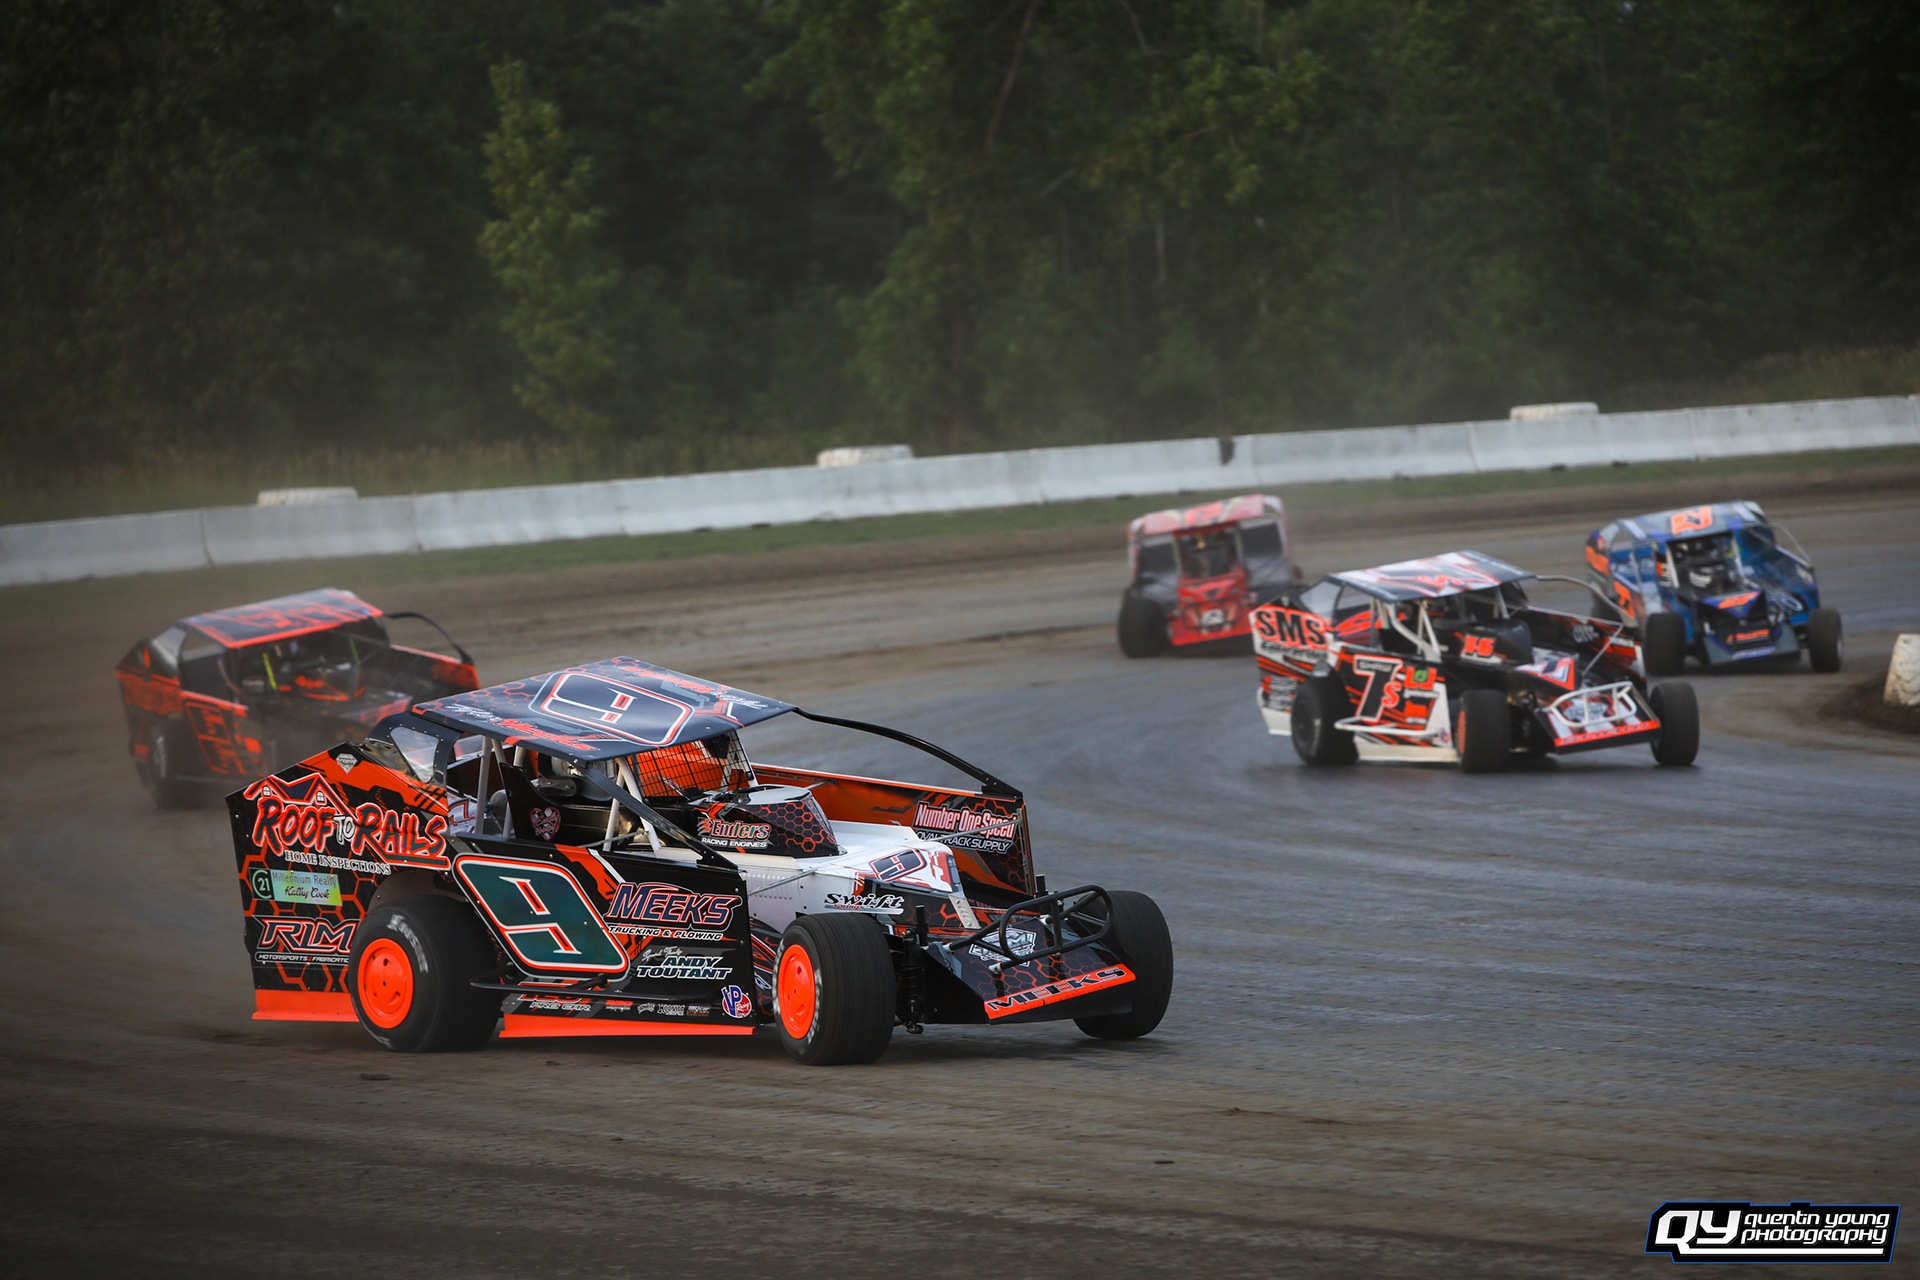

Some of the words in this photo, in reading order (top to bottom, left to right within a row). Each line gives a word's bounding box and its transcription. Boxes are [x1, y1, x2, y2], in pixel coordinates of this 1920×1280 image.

[1257, 609, 1327, 646] SMS
[252, 796, 336, 856] ROOF
[333, 815, 356, 845] TO
[351, 803, 447, 856] RAILS
[711, 820, 771, 839] Enders
[915, 803, 960, 830] Number
[959, 809, 981, 832] One
[980, 813, 1017, 839] Speed
[701, 837, 728, 846] RACING
[971, 838, 1009, 852] SUPPLY
[284, 850, 317, 865] HOME
[319, 853, 392, 876] INSPECTIONS
[272, 871, 312, 885] Millennium
[313, 874, 337, 889] Realty
[310, 886, 331, 899] Cook
[824, 892, 904, 909] Swift
[606, 883, 740, 926] MEEKS
[456, 856, 627, 974] 9
[261, 919, 358, 953] RIM
[609, 926, 661, 937] TRUCKING
[673, 931, 723, 941] PLOWING
[258, 954, 308, 962] MOTORSPORTS
[661, 955, 723, 967] ANDY
[637, 965, 733, 980] TOUTANT
[986, 966, 1127, 1011] MEEKS
[721, 985, 743, 1017] VP
